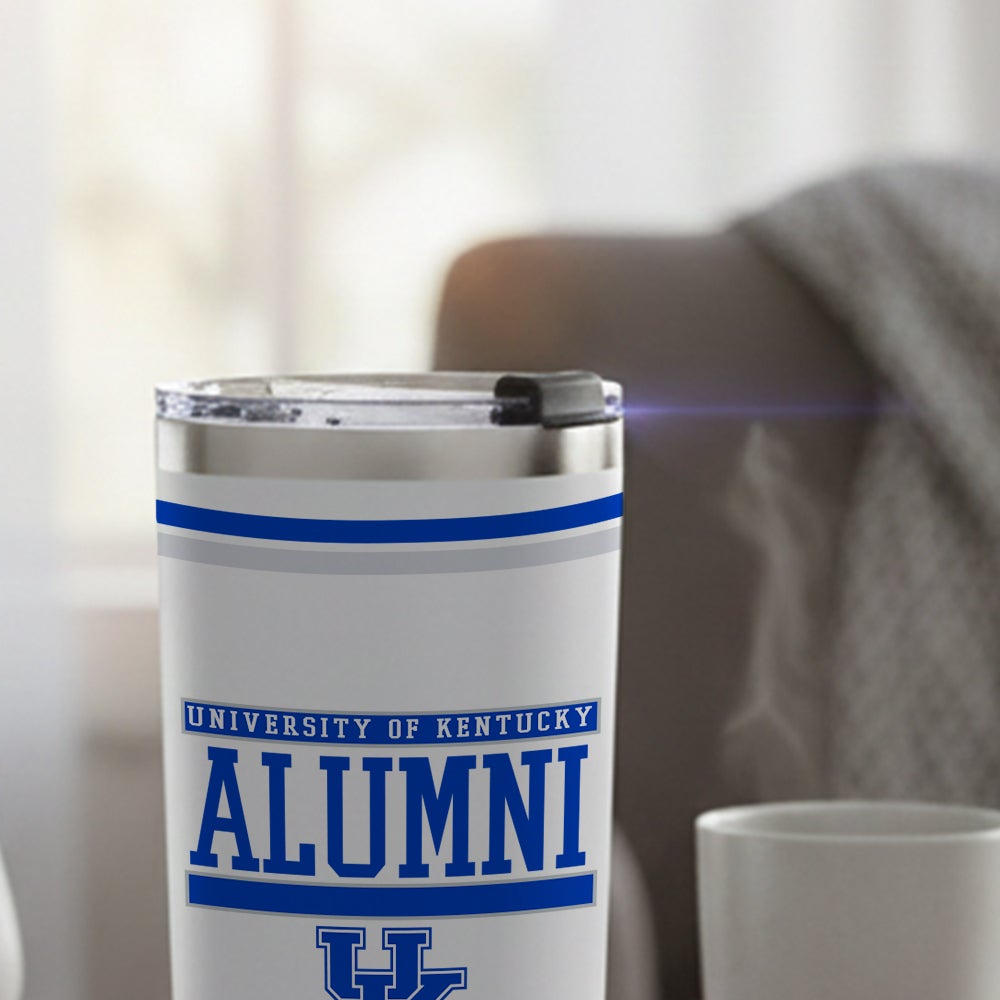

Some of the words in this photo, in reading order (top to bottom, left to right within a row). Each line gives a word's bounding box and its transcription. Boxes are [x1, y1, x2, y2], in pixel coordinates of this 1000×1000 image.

[186, 705, 371, 739] UNIVERSITY
[388, 719, 420, 739] OF
[436, 705, 593, 739] KENTUCKY
[189, 744, 589, 878] ALUMNI
